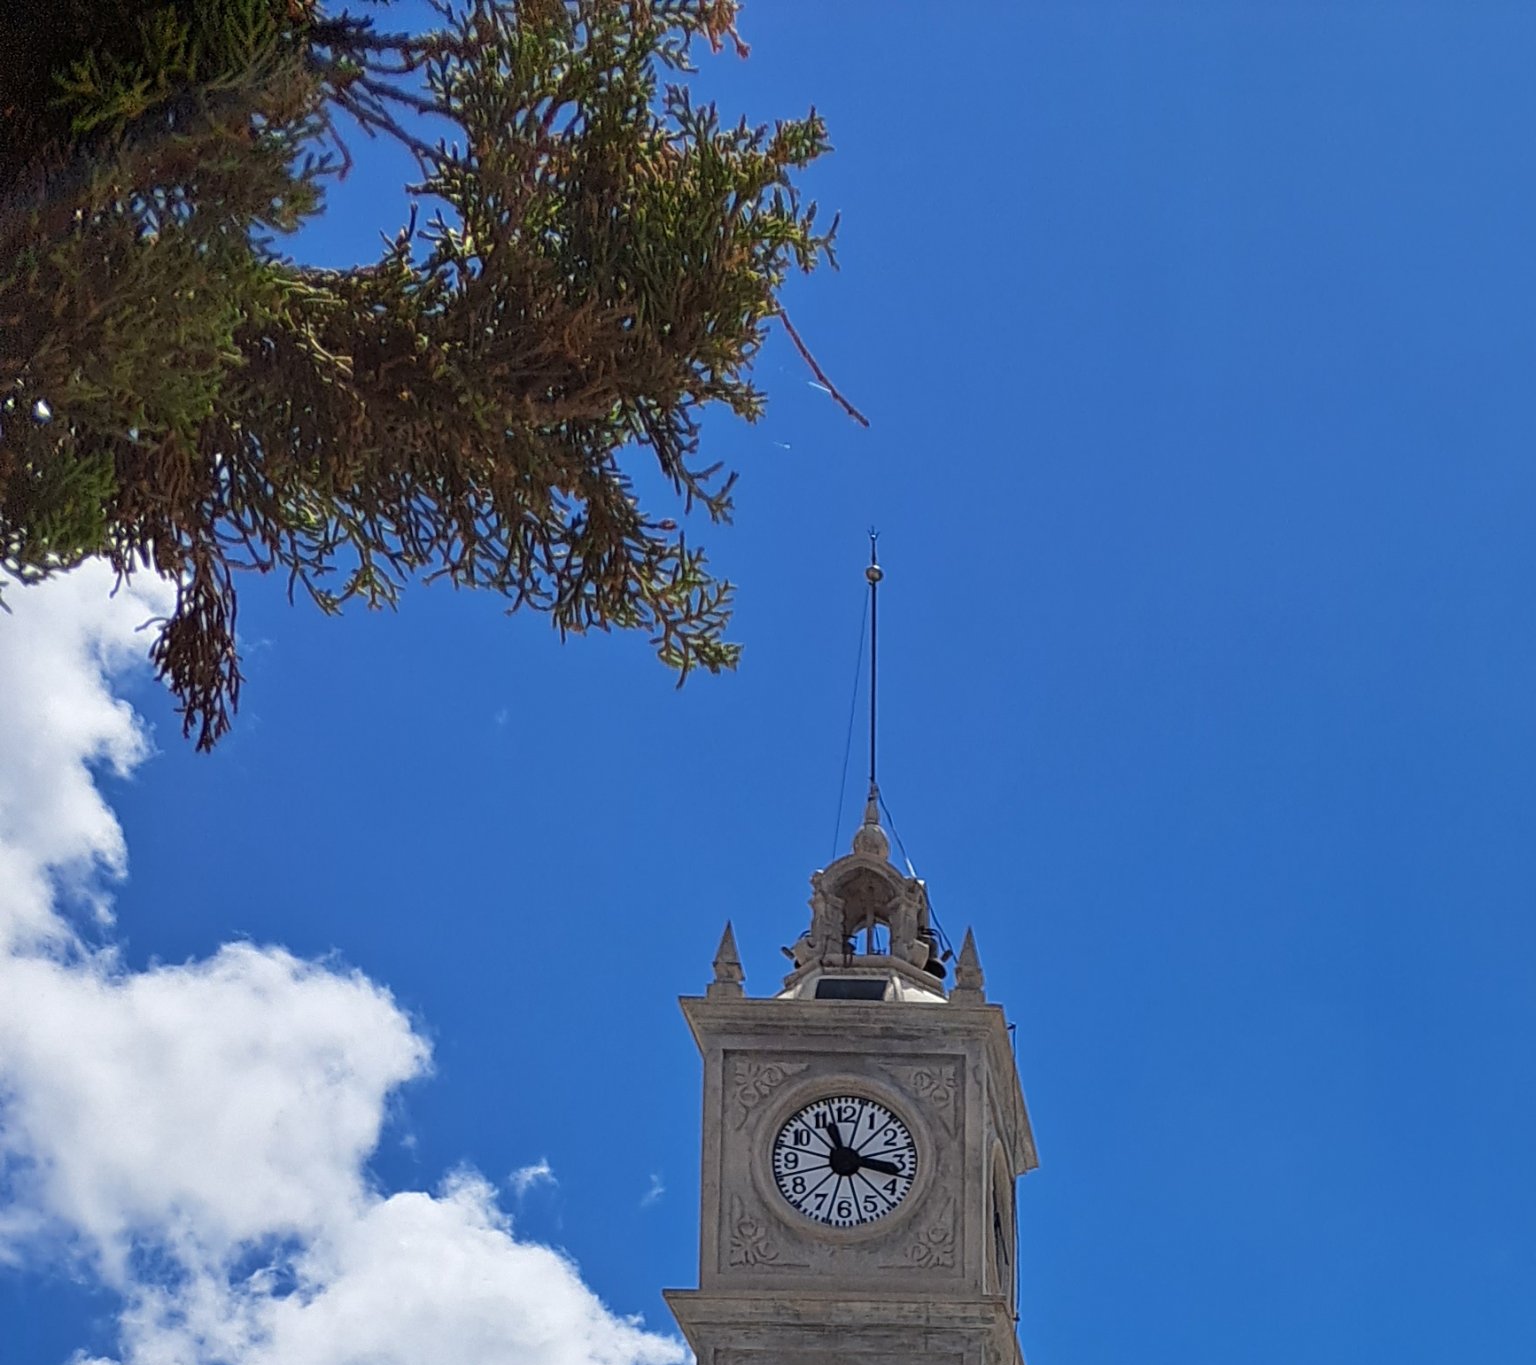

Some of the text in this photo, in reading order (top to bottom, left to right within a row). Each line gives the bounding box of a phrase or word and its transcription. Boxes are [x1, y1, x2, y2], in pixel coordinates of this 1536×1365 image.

[814, 1111, 829, 1129] 11
[836, 1105, 857, 1123] 12
[868, 1112, 875, 1130] 1
[792, 1128, 811, 1147] 10
[883, 1128, 897, 1146] 2
[784, 1151, 799, 1169] 9
[893, 1153, 906, 1171] 3
[792, 1176, 807, 1194] 8
[883, 1178, 897, 1196] 4
[814, 1193, 829, 1211] 7
[837, 1200, 852, 1218] 6
[863, 1195, 878, 1213] 5
